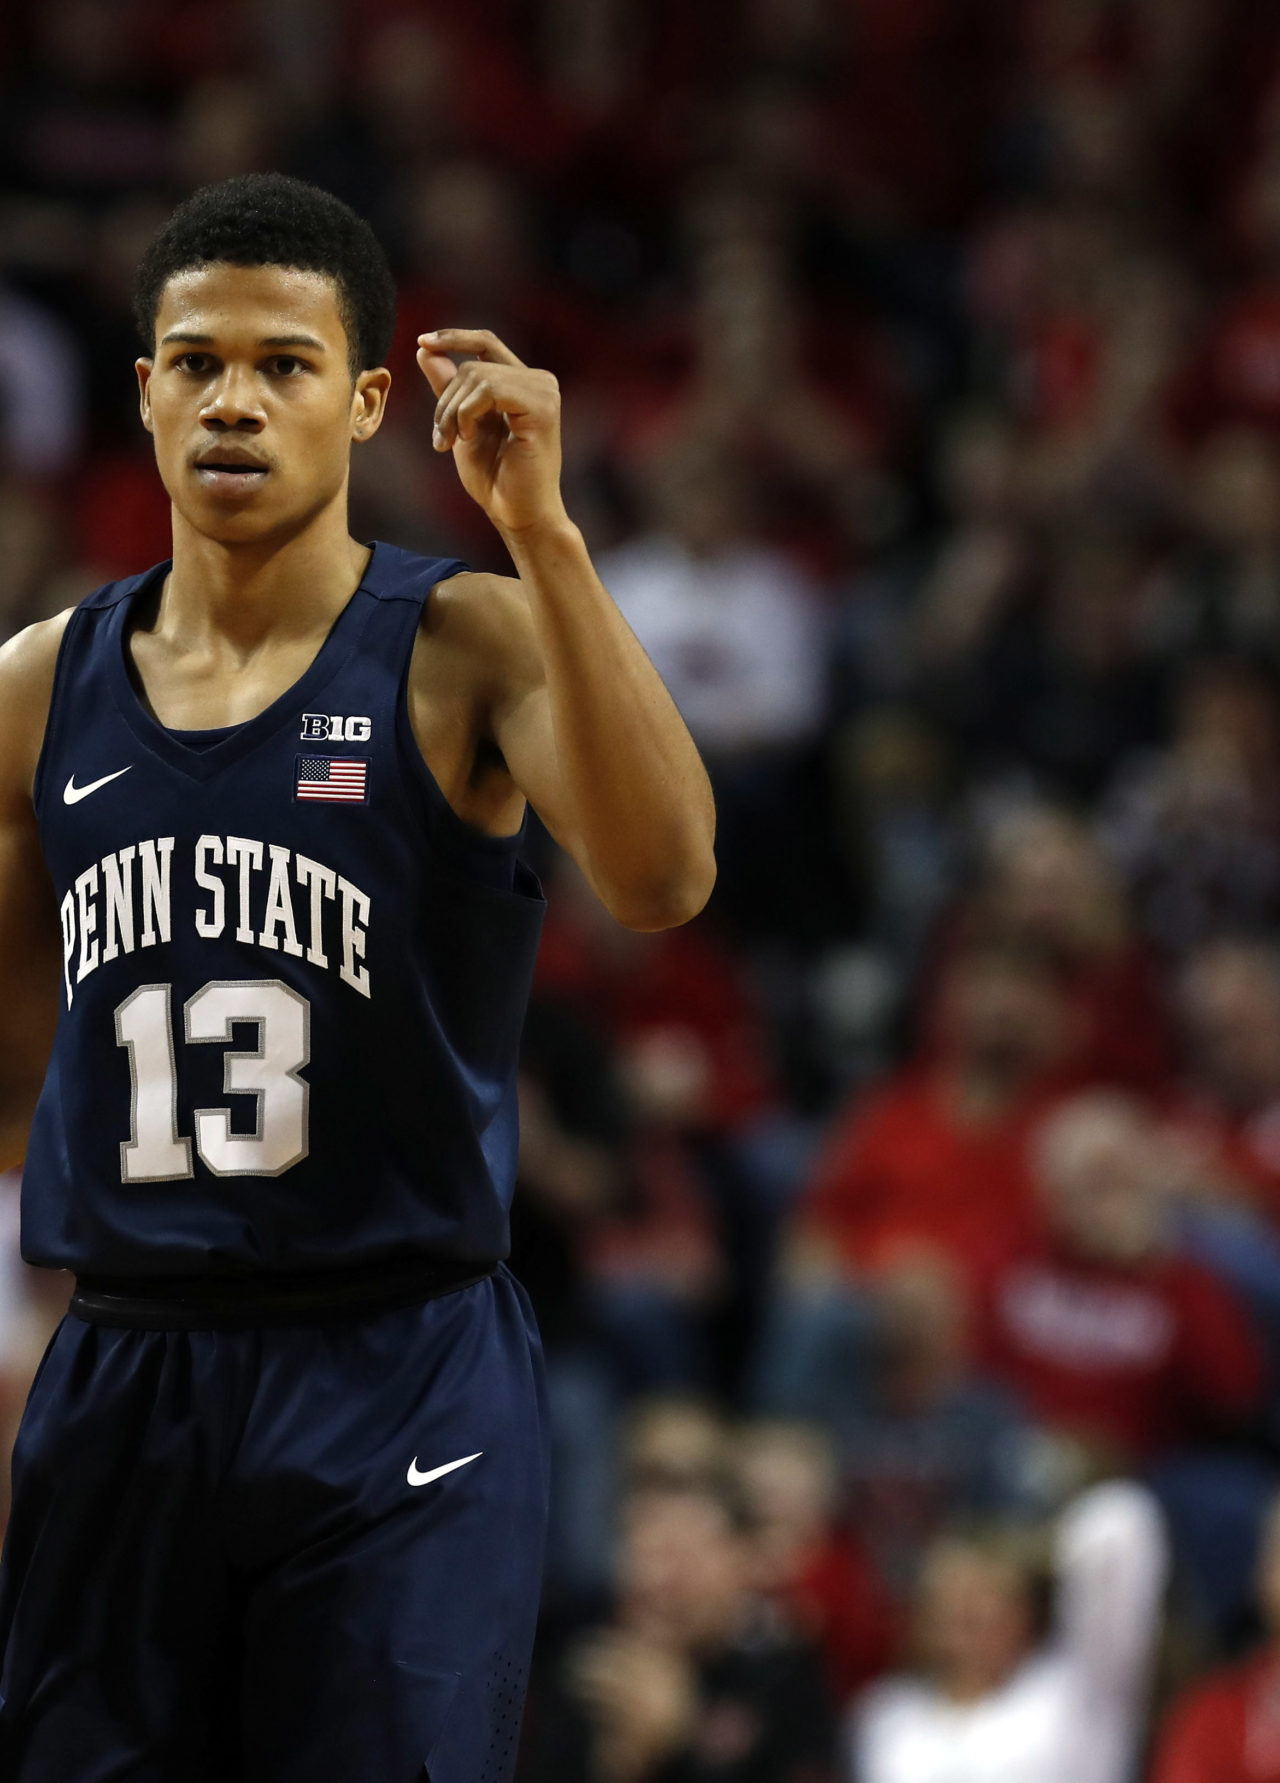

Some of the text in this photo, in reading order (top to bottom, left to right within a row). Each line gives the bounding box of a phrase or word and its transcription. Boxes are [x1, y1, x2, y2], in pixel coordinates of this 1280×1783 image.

[61, 834, 371, 1011] PENN STATE
[114, 979, 311, 1184] 13
